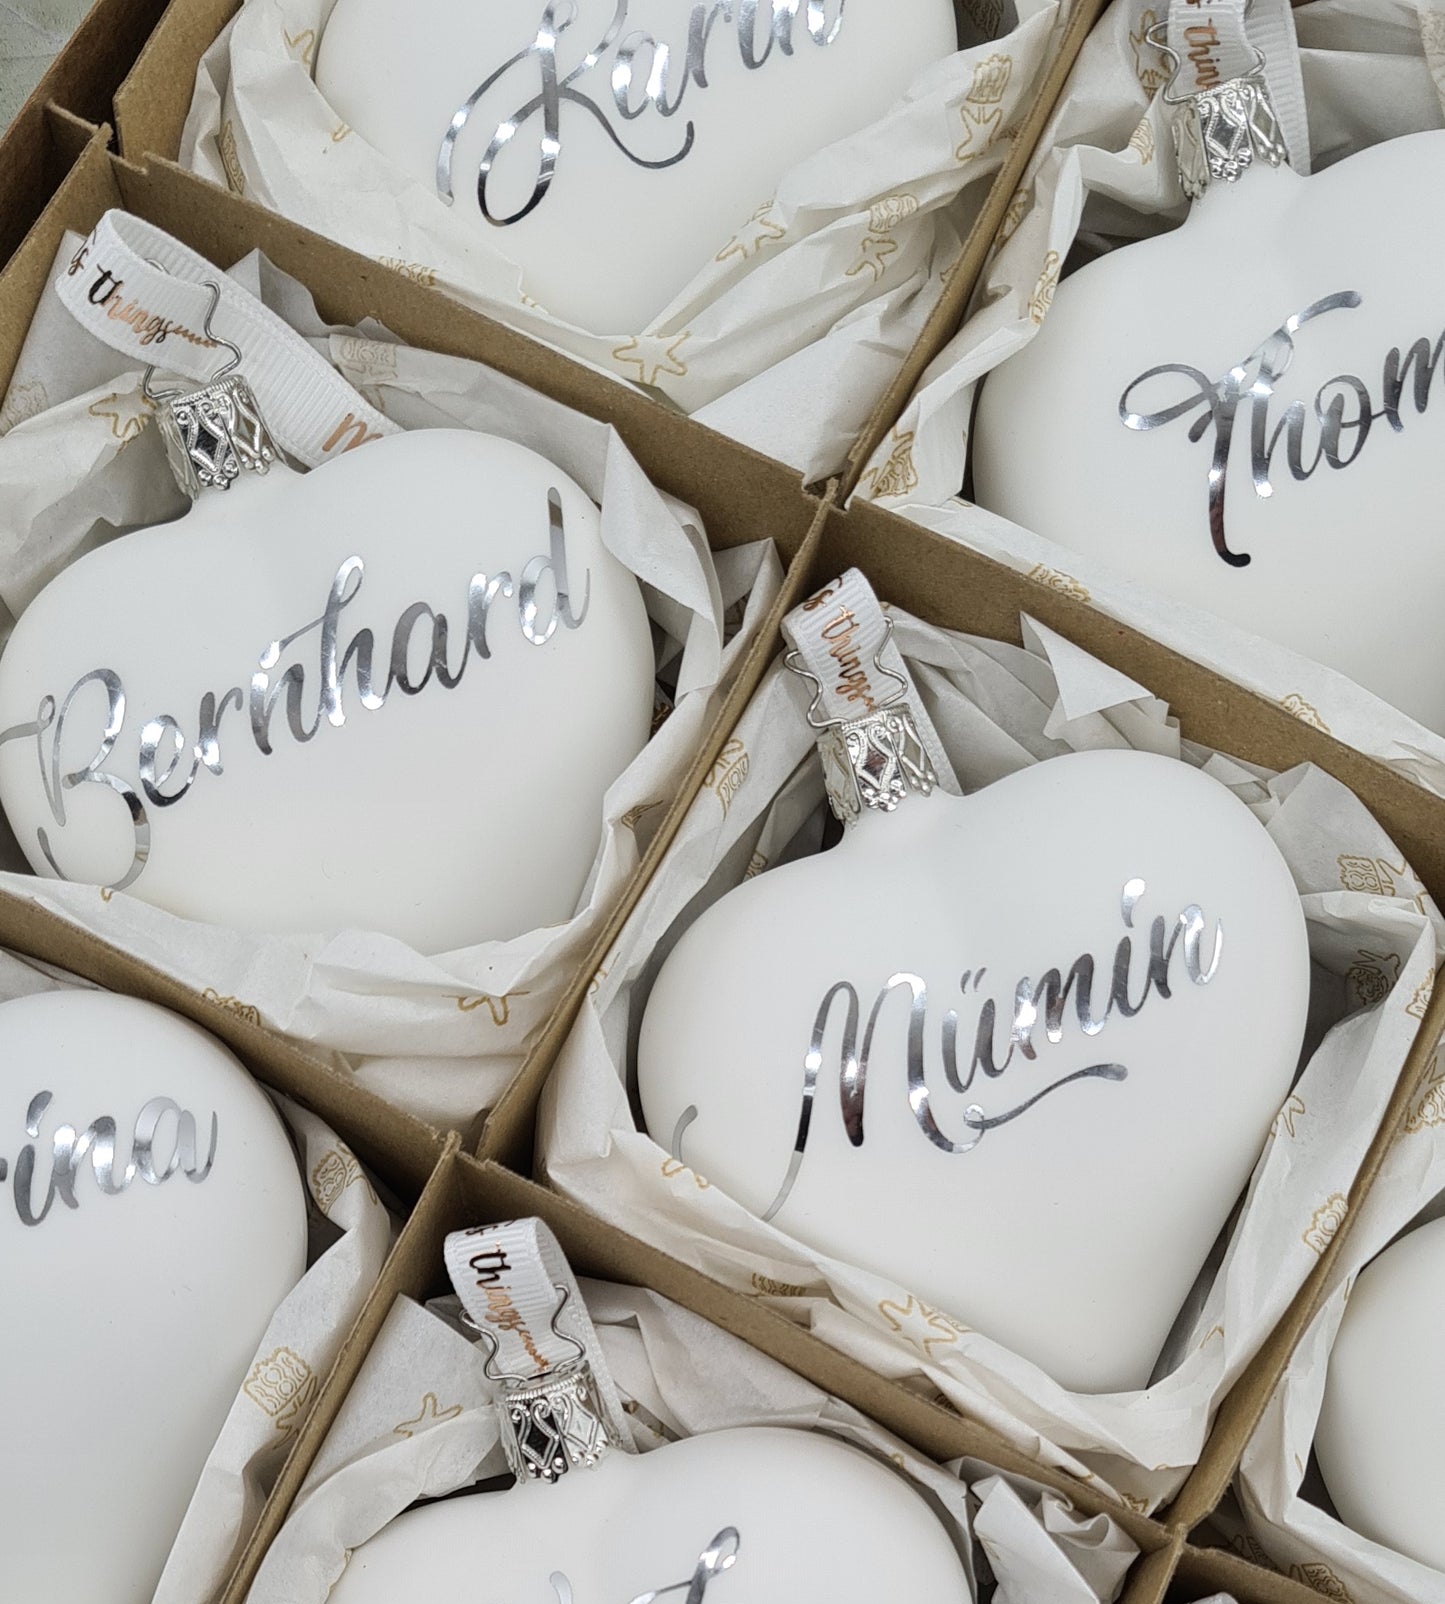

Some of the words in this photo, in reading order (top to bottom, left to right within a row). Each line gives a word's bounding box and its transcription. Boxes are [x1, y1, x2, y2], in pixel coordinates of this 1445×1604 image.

[0, 487, 590, 892] Bernhard
[0, 1090, 219, 1226] ina
[671, 878, 1224, 1221] Mümin
